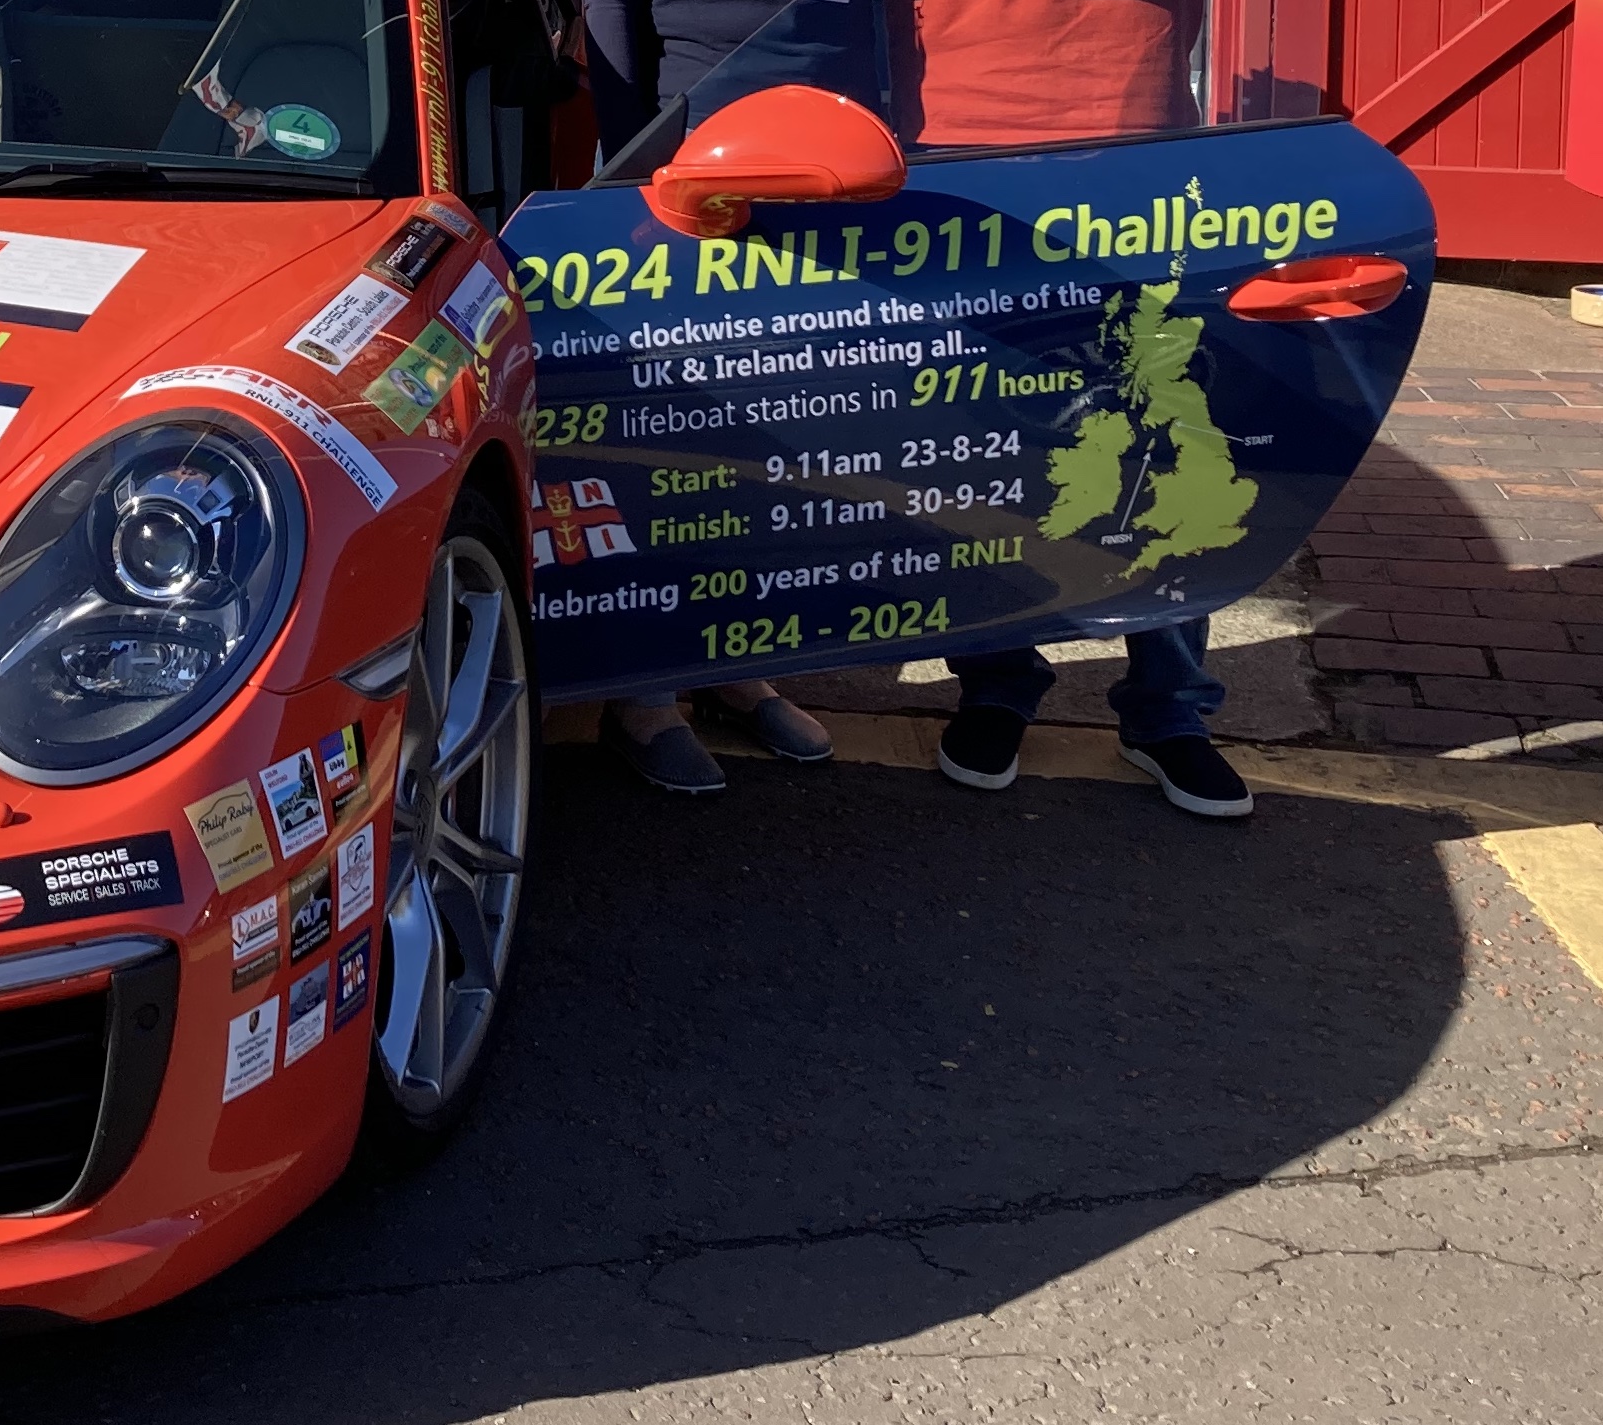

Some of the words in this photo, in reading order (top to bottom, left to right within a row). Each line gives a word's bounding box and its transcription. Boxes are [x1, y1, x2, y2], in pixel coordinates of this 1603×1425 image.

[291, 113, 311, 134] 4
[517, 242, 672, 313] 2024
[695, 214, 1002, 296] RNLI-911
[1032, 196, 1339, 263] Challenge
[308, 294, 360, 338] PORSCHE
[553, 330, 621, 359] drive
[629, 315, 764, 351] clockwise
[771, 299, 872, 334] around
[878, 297, 925, 324] the
[931, 290, 1013, 319] whole
[1021, 284, 1051, 310] of
[1059, 281, 1102, 308] the
[632, 359, 675, 389] UK
[681, 356, 708, 384] &
[714, 347, 813, 379] Ireland
[821, 338, 924, 369] visiting
[535, 402, 609, 448] 238
[622, 401, 737, 439] lifeboat
[744, 389, 861, 423] stations
[871, 382, 897, 409] in
[909, 361, 988, 407] 911
[998, 366, 1084, 397] hours
[245, 388, 310, 431] RNLI-911
[311, 430, 383, 506] CHALLENGE
[649, 463, 739, 498] Start:
[765, 448, 883, 484] 9.11am
[900, 429, 1022, 469] 23-8-24
[1244, 433, 1275, 447] START
[649, 512, 752, 547] Finish:
[770, 496, 886, 532] 9.11am
[904, 478, 1025, 517] 30-9-24
[1100, 533, 1134, 546] FINISH
[689, 569, 748, 602] 200
[755, 561, 839, 601] years
[848, 551, 884, 581] of
[890, 547, 941, 576] the
[949, 536, 1025, 569] RNLI
[701, 613, 803, 660] 1824
[847, 596, 951, 643] 2024
[197, 813, 228, 836] Philip
[40, 847, 129, 875] PORSCHE
[44, 859, 160, 891] SPECIALISTS
[48, 888, 90, 907] SERVICE
[94, 883, 126, 900] SALES
[130, 877, 160, 893] TRACK
